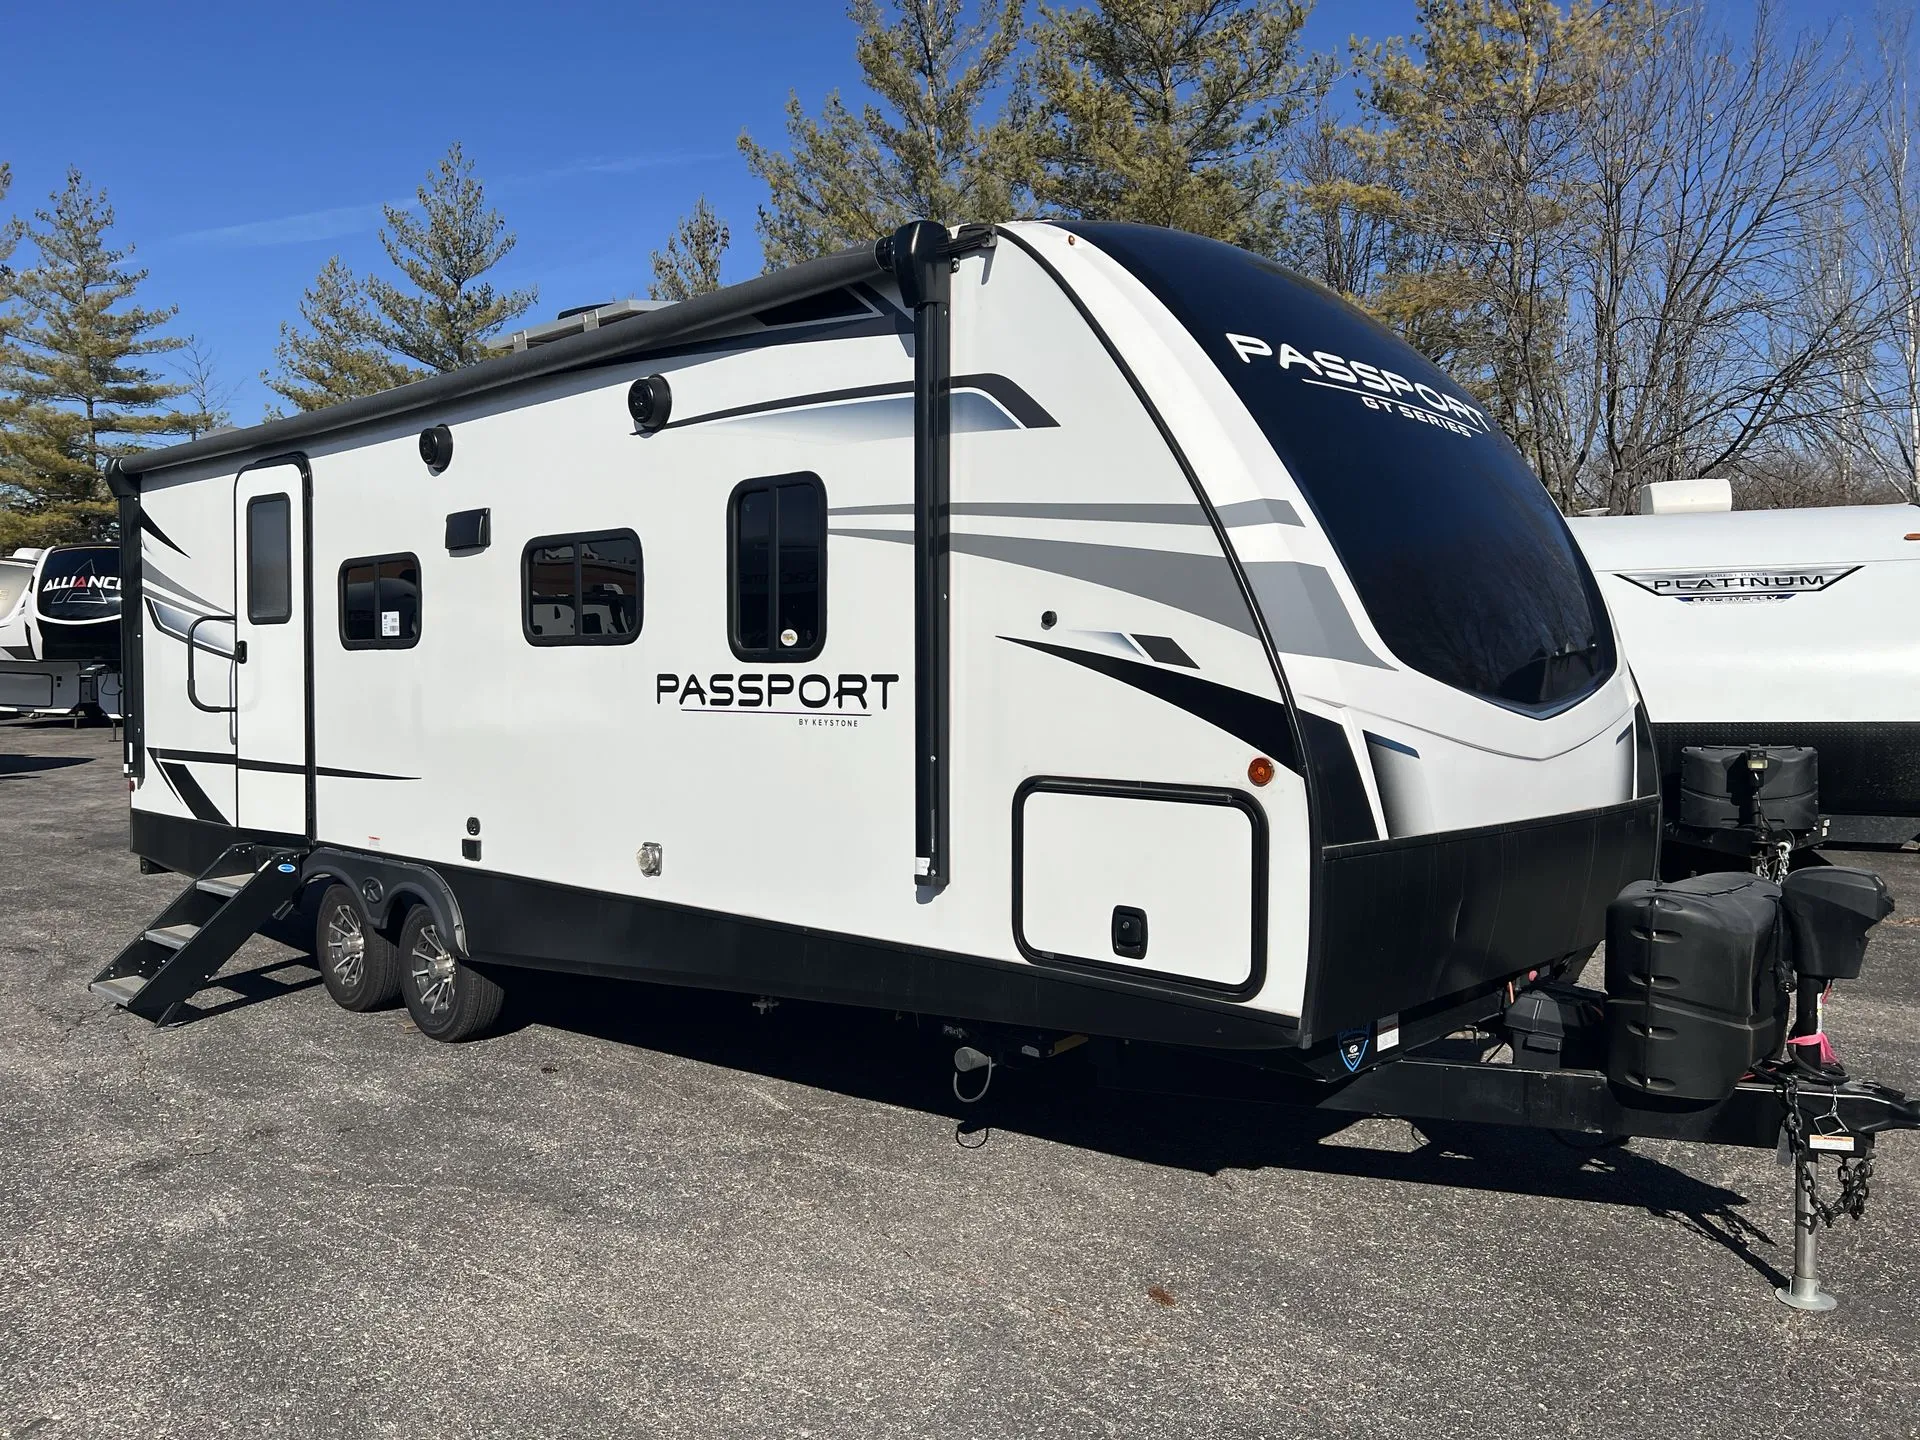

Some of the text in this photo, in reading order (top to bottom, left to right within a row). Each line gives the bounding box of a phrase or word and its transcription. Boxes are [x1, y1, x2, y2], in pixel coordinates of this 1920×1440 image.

[1225, 333, 1491, 432] PASSPORT
[1361, 396, 1472, 438] GT SERIES
[1653, 575, 1825, 591] PLATINUM
[657, 673, 900, 710] PASSPORT
[798, 718, 858, 728] BY KEYSTONE
